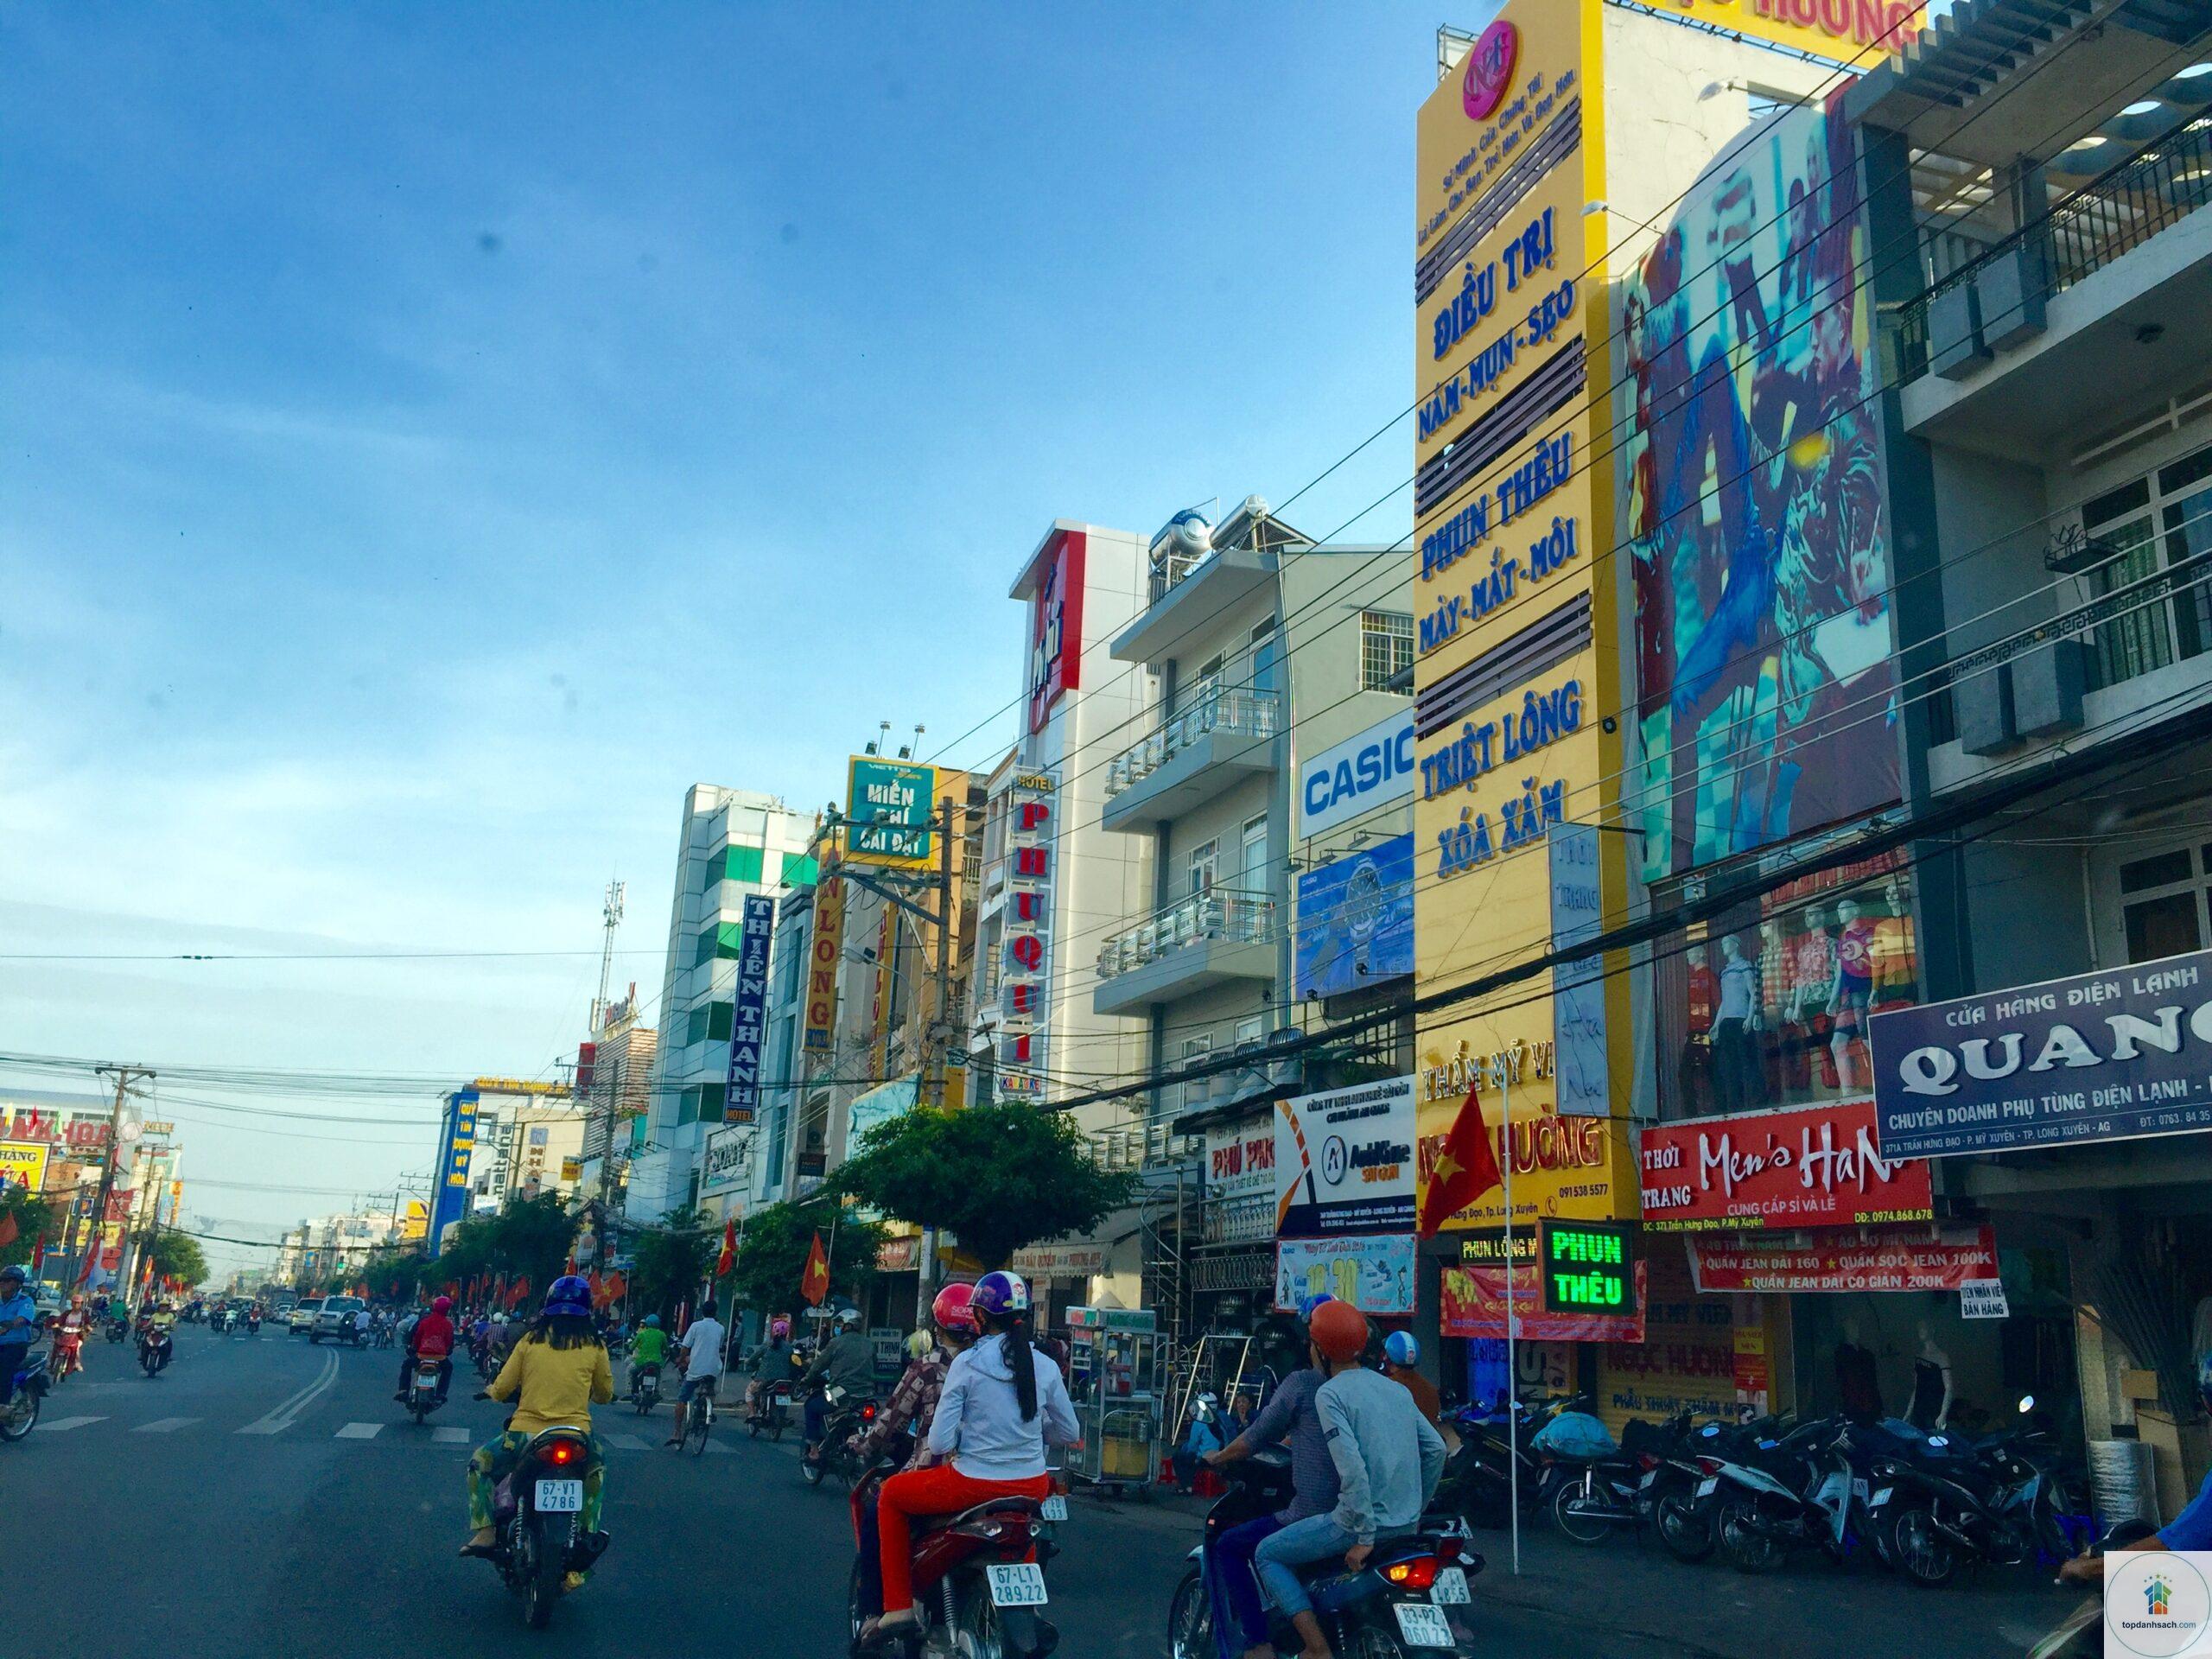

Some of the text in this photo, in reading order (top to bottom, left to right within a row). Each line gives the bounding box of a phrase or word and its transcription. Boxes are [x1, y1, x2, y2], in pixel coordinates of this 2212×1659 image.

[1433, 206, 1555, 361] ĐIỀU TRỊ
[1421, 431, 1573, 582] PHUN THÊU
[1420, 680, 1581, 801] TRIỆT LÔNG
[1019, 776, 1054, 791] HOTEL
[1438, 777, 1567, 879] XÓA XĂM
[729, 899, 771, 1103] THIÊN THANH
[1946, 967, 2198, 1027] CỬA HÀNG ĐIỆN LẠNH
[726, 1109, 753, 1122] HOTEL
[1889, 1078, 2188, 1130] CHUYÊN DOANH PHỤ TÙNG ĐIỆN LẠNH
[1885, 1143, 1902, 1154] 371A
[1945, 1135, 1961, 1148] ĐẠO
[1990, 1129, 2015, 1143] XUYÊN
[2037, 1125, 2059, 1138] LONG
[2062, 1121, 2091, 1136] XUYÊN
[2098, 1122, 2111, 1132] AG
[1644, 1140, 1680, 1170] THỜI
[1699, 1133, 1791, 1198] Men's
[1643, 1185, 1691, 1210] TRANG
[1727, 1203, 1759, 1217] CUNG
[1763, 1193, 1786, 1215] CẤP
[1802, 1194, 1819, 1212] VÀ
[1872, 1209, 1933, 1223] 0974.868.678
[1463, 1240, 1491, 1258] PHUN
[1553, 1231, 1621, 1263] PHUN
[1912, 1253, 1948, 1267] JEAN
[1952, 1251, 1992, 1266] 100K
[1740, 1258, 1768, 1269] JEAN
[1796, 1257, 1819, 1268] 160
[1554, 1270, 1621, 1305] THÊU
[1789, 1276, 1817, 1288] JEAN
[1907, 1275, 1944, 1287] 200K
[1964, 1301, 2004, 1316] BÁN HÀNG
[543, 1483, 575, 1495] 67-V1
[543, 1497, 575, 1509] 4786
[996, 1567, 1033, 1584] 67-L1
[995, 1585, 1043, 1603] 289.22
